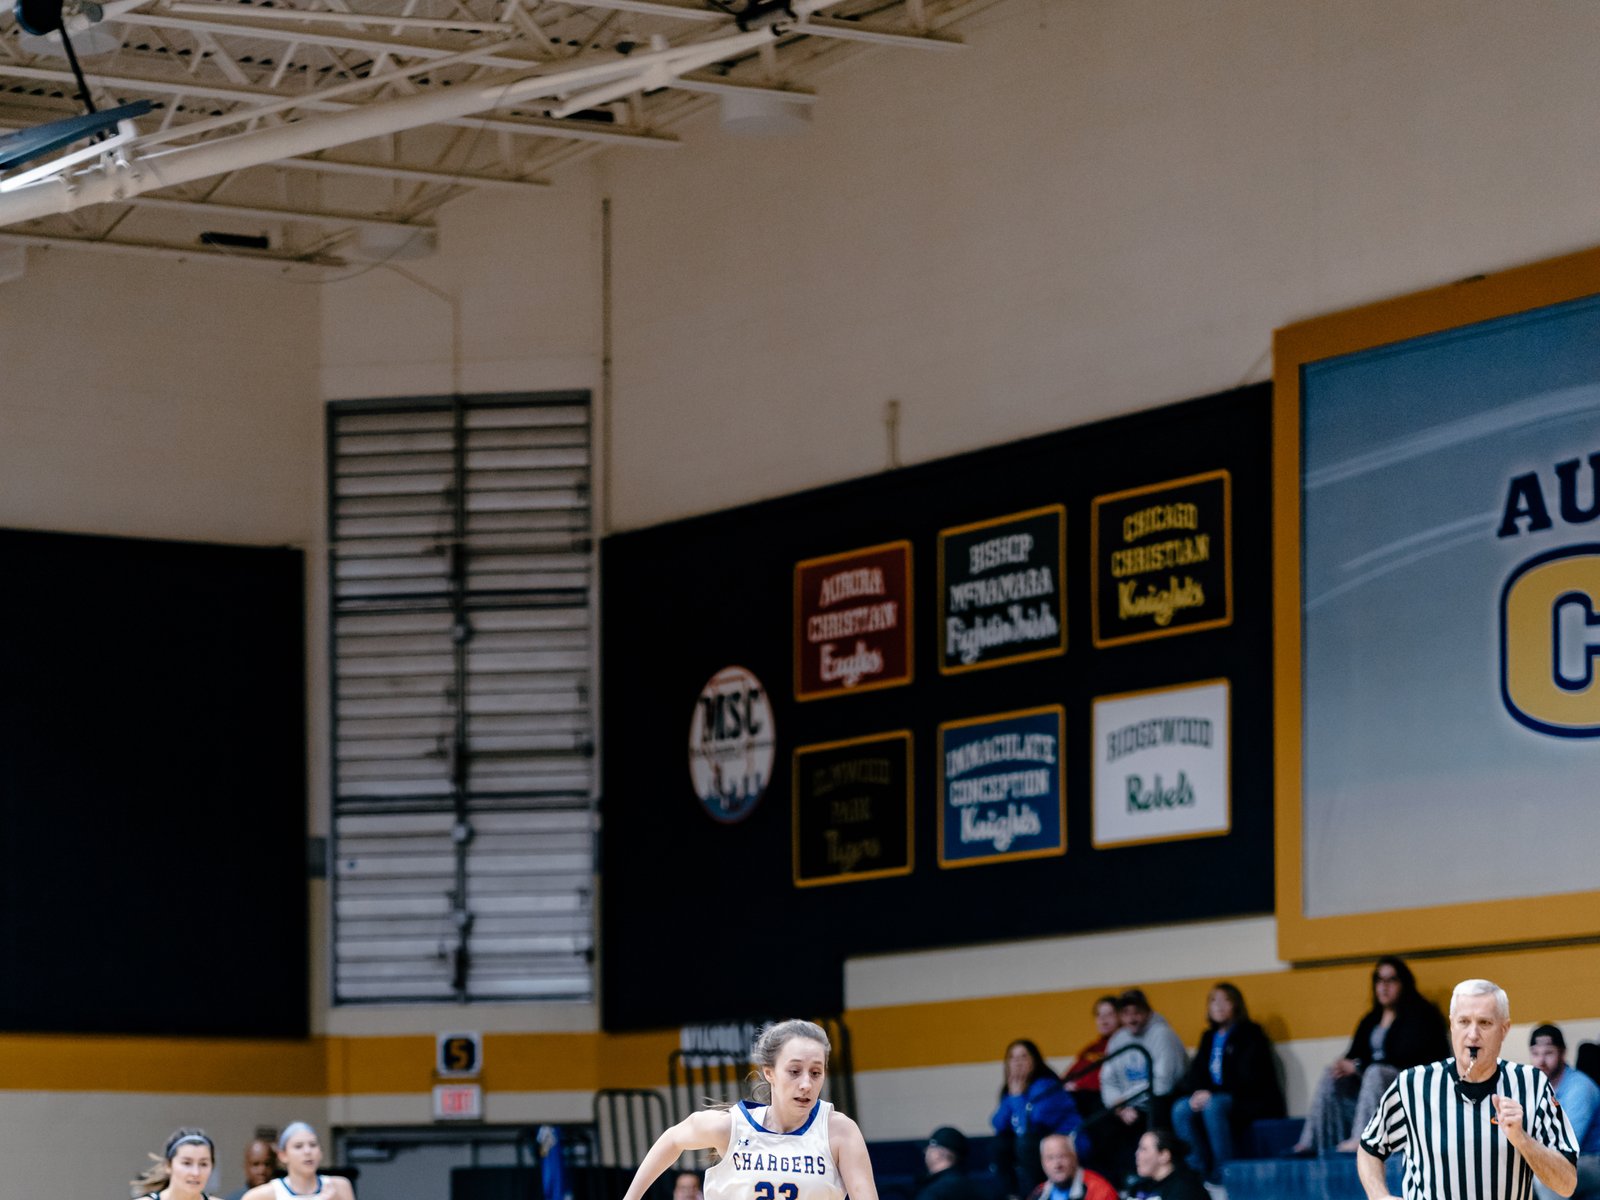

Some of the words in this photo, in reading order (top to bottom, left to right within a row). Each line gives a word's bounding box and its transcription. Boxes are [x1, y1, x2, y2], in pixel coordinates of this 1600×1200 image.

[1123, 503, 1198, 542] CHICAGO
[969, 533, 1034, 574] BISHOP
[1111, 533, 1210, 578] CHRISTIAN
[819, 567, 886, 608] AURORA
[1118, 575, 1205, 625] Knights
[808, 601, 898, 643] CHRISTIAN
[820, 640, 884, 688] Eagles
[946, 733, 1056, 778] IMMACULATE
[1106, 716, 1214, 764] RIDGEWOOD
[950, 768, 1050, 807] CONCEPTION
[1126, 769, 1195, 815] Rebels
[960, 803, 1042, 852] Knights
[449, 1037, 469, 1071] 5
[732, 1152, 826, 1175] CHARGERS
